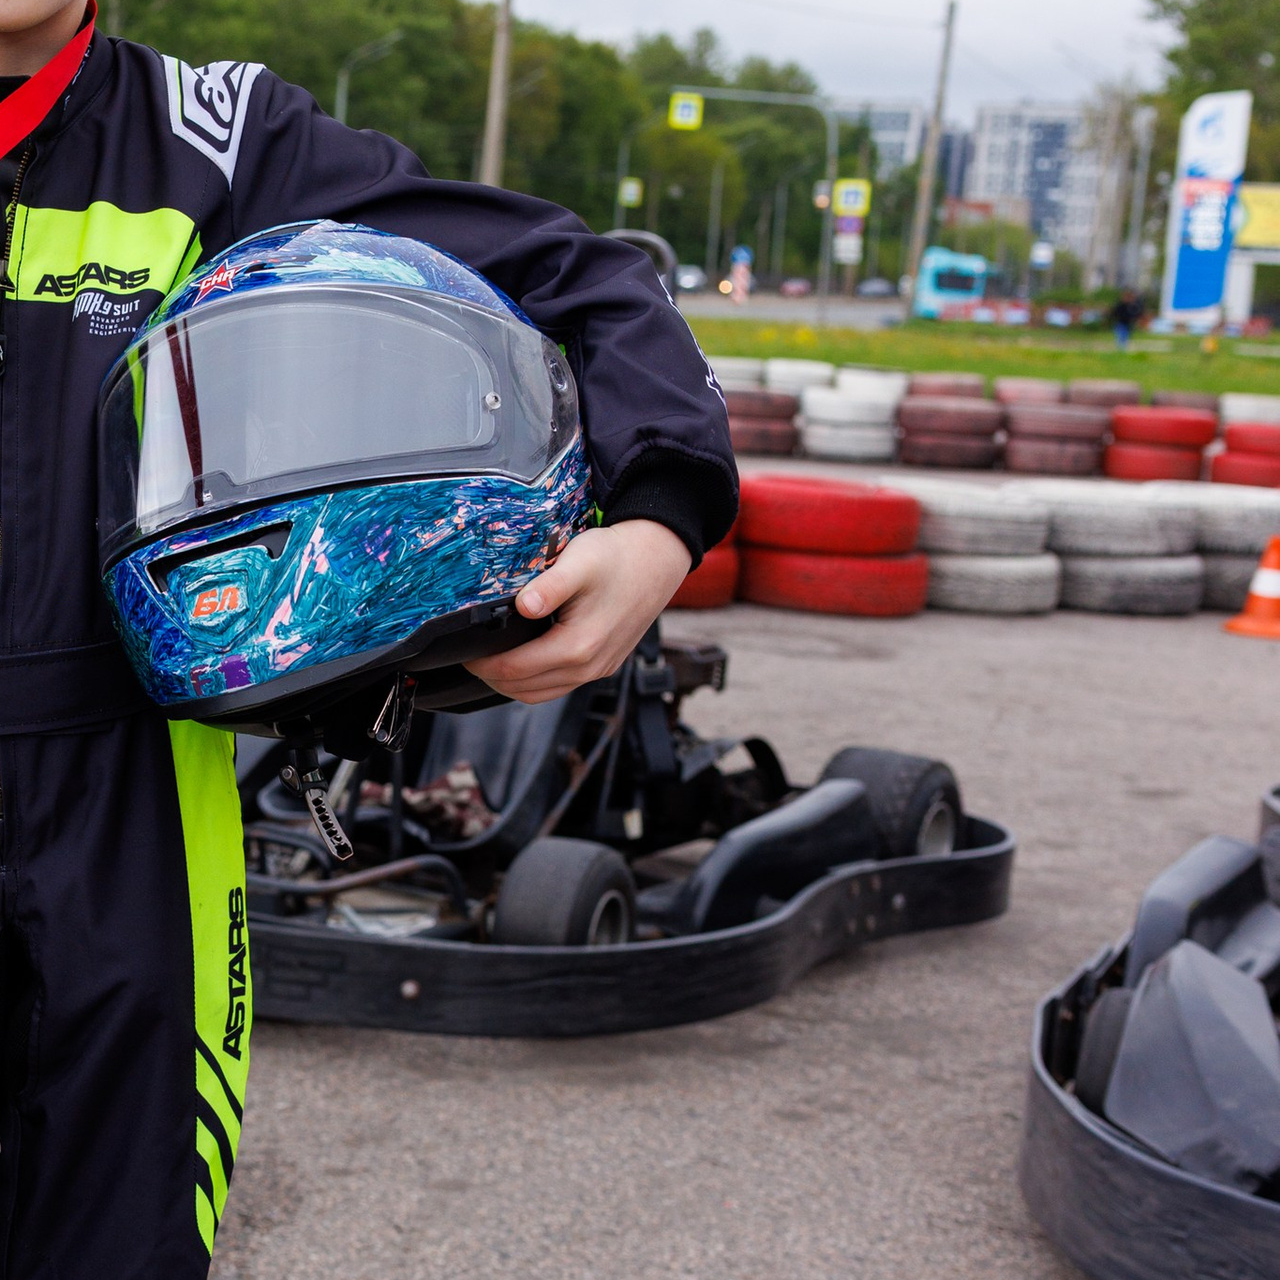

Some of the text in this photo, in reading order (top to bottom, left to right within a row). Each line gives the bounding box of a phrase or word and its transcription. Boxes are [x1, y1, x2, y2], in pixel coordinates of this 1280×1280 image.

[33, 262, 150, 297] ASTARS
[113, 300, 140, 316] SUIT
[89, 322, 119, 330] RACING
[90, 315, 130, 323] ADVANCED
[222, 886, 246, 1061] ASTARS
